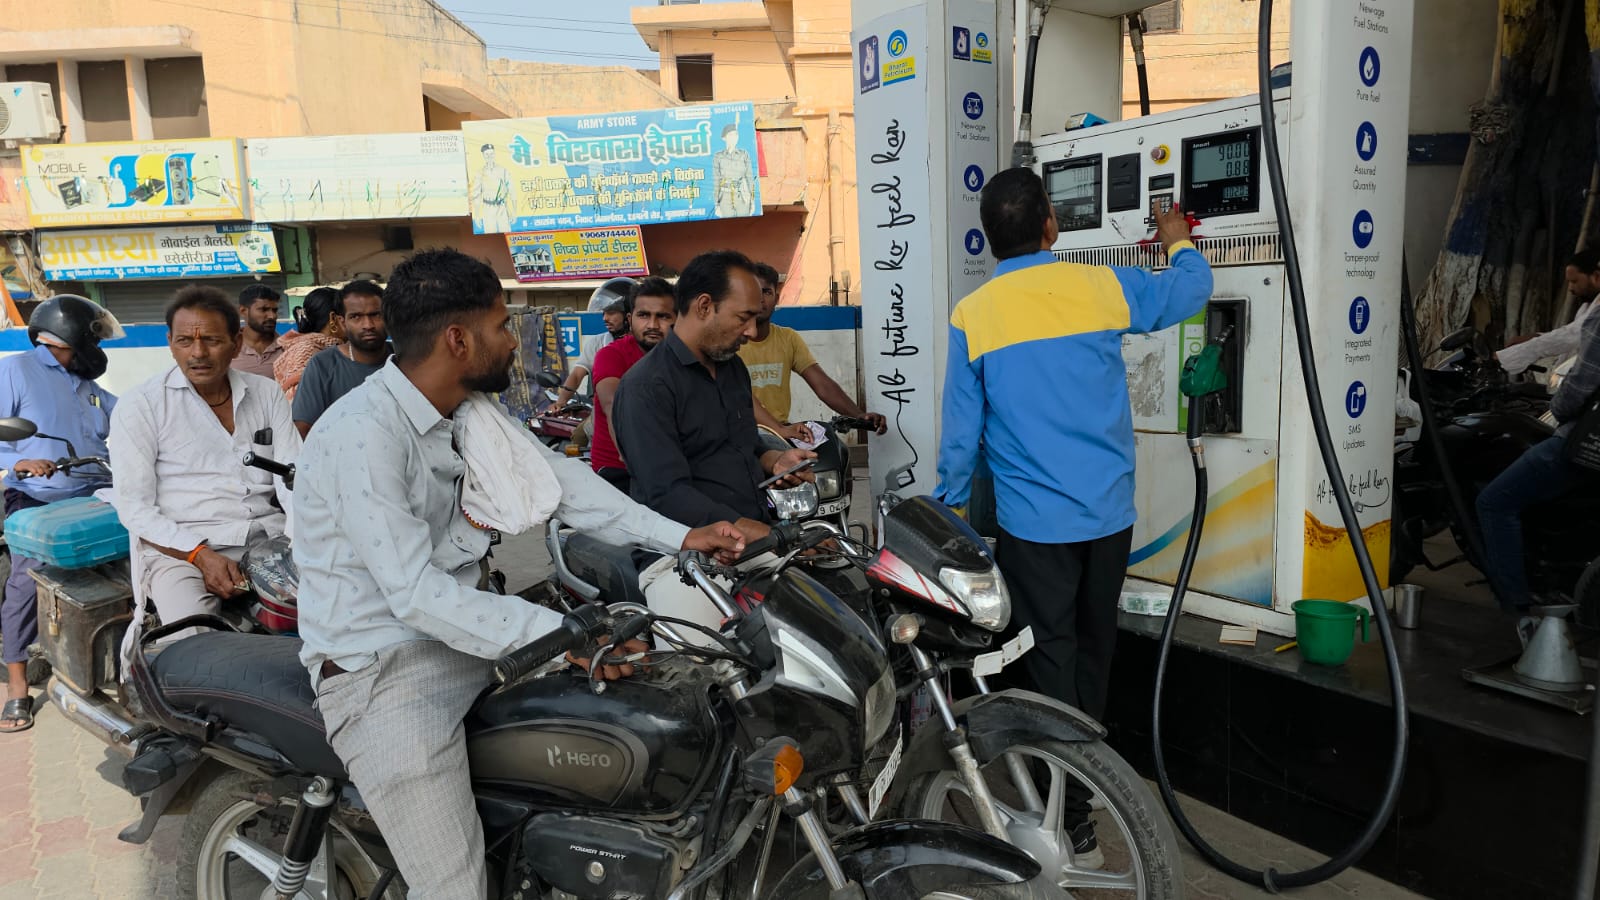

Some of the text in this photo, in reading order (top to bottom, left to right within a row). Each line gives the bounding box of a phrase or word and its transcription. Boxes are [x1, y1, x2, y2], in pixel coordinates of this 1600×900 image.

[1354, 16, 1389, 34] Fuel Stations
[1356, 90, 1369, 101] Pure
[578, 116, 638, 129] ARMY STORE
[38, 162, 88, 174] MOBILE
[1354, 166, 1376, 176] Assured
[1352, 180, 1376, 193] Quantity
[871, 176, 916, 228] feel
[874, 240, 908, 271] ko
[1346, 266, 1376, 280] technology
[880, 283, 919, 357] future
[1345, 354, 1370, 366] Payments
[877, 368, 916, 404] Ab
[1348, 424, 1361, 434] SMS
[1342, 439, 1366, 452] Updates
[566, 751, 611, 768] Hero
[570, 844, 598, 856] POWER
